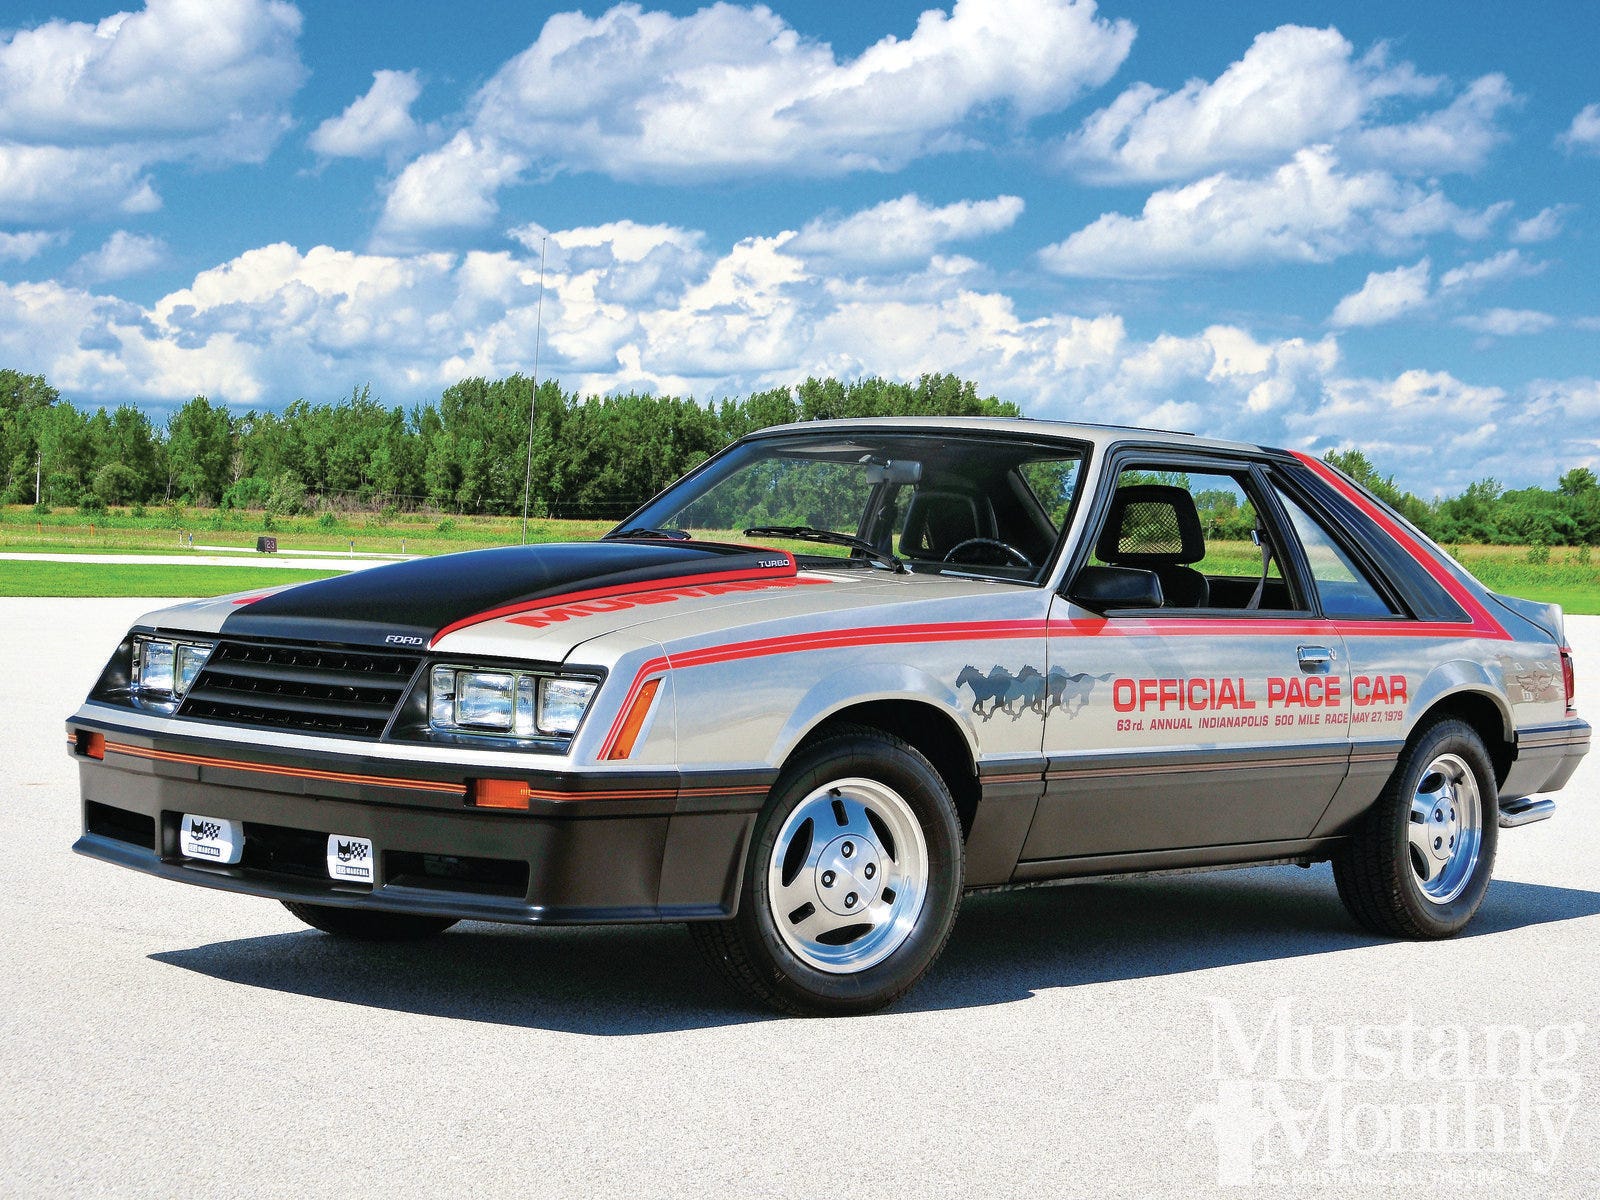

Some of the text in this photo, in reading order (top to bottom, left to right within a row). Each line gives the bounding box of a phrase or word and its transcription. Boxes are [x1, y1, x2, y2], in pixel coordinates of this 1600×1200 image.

[758, 559, 790, 568] TURBO
[385, 635, 423, 645] FORD
[1113, 674, 1407, 713] OFFICIAL PACE CAR
[1116, 710, 1404, 732] 63rd. ANNUAL INDIANAPOLIS 500 MILE RACE MAY 27, 1979
